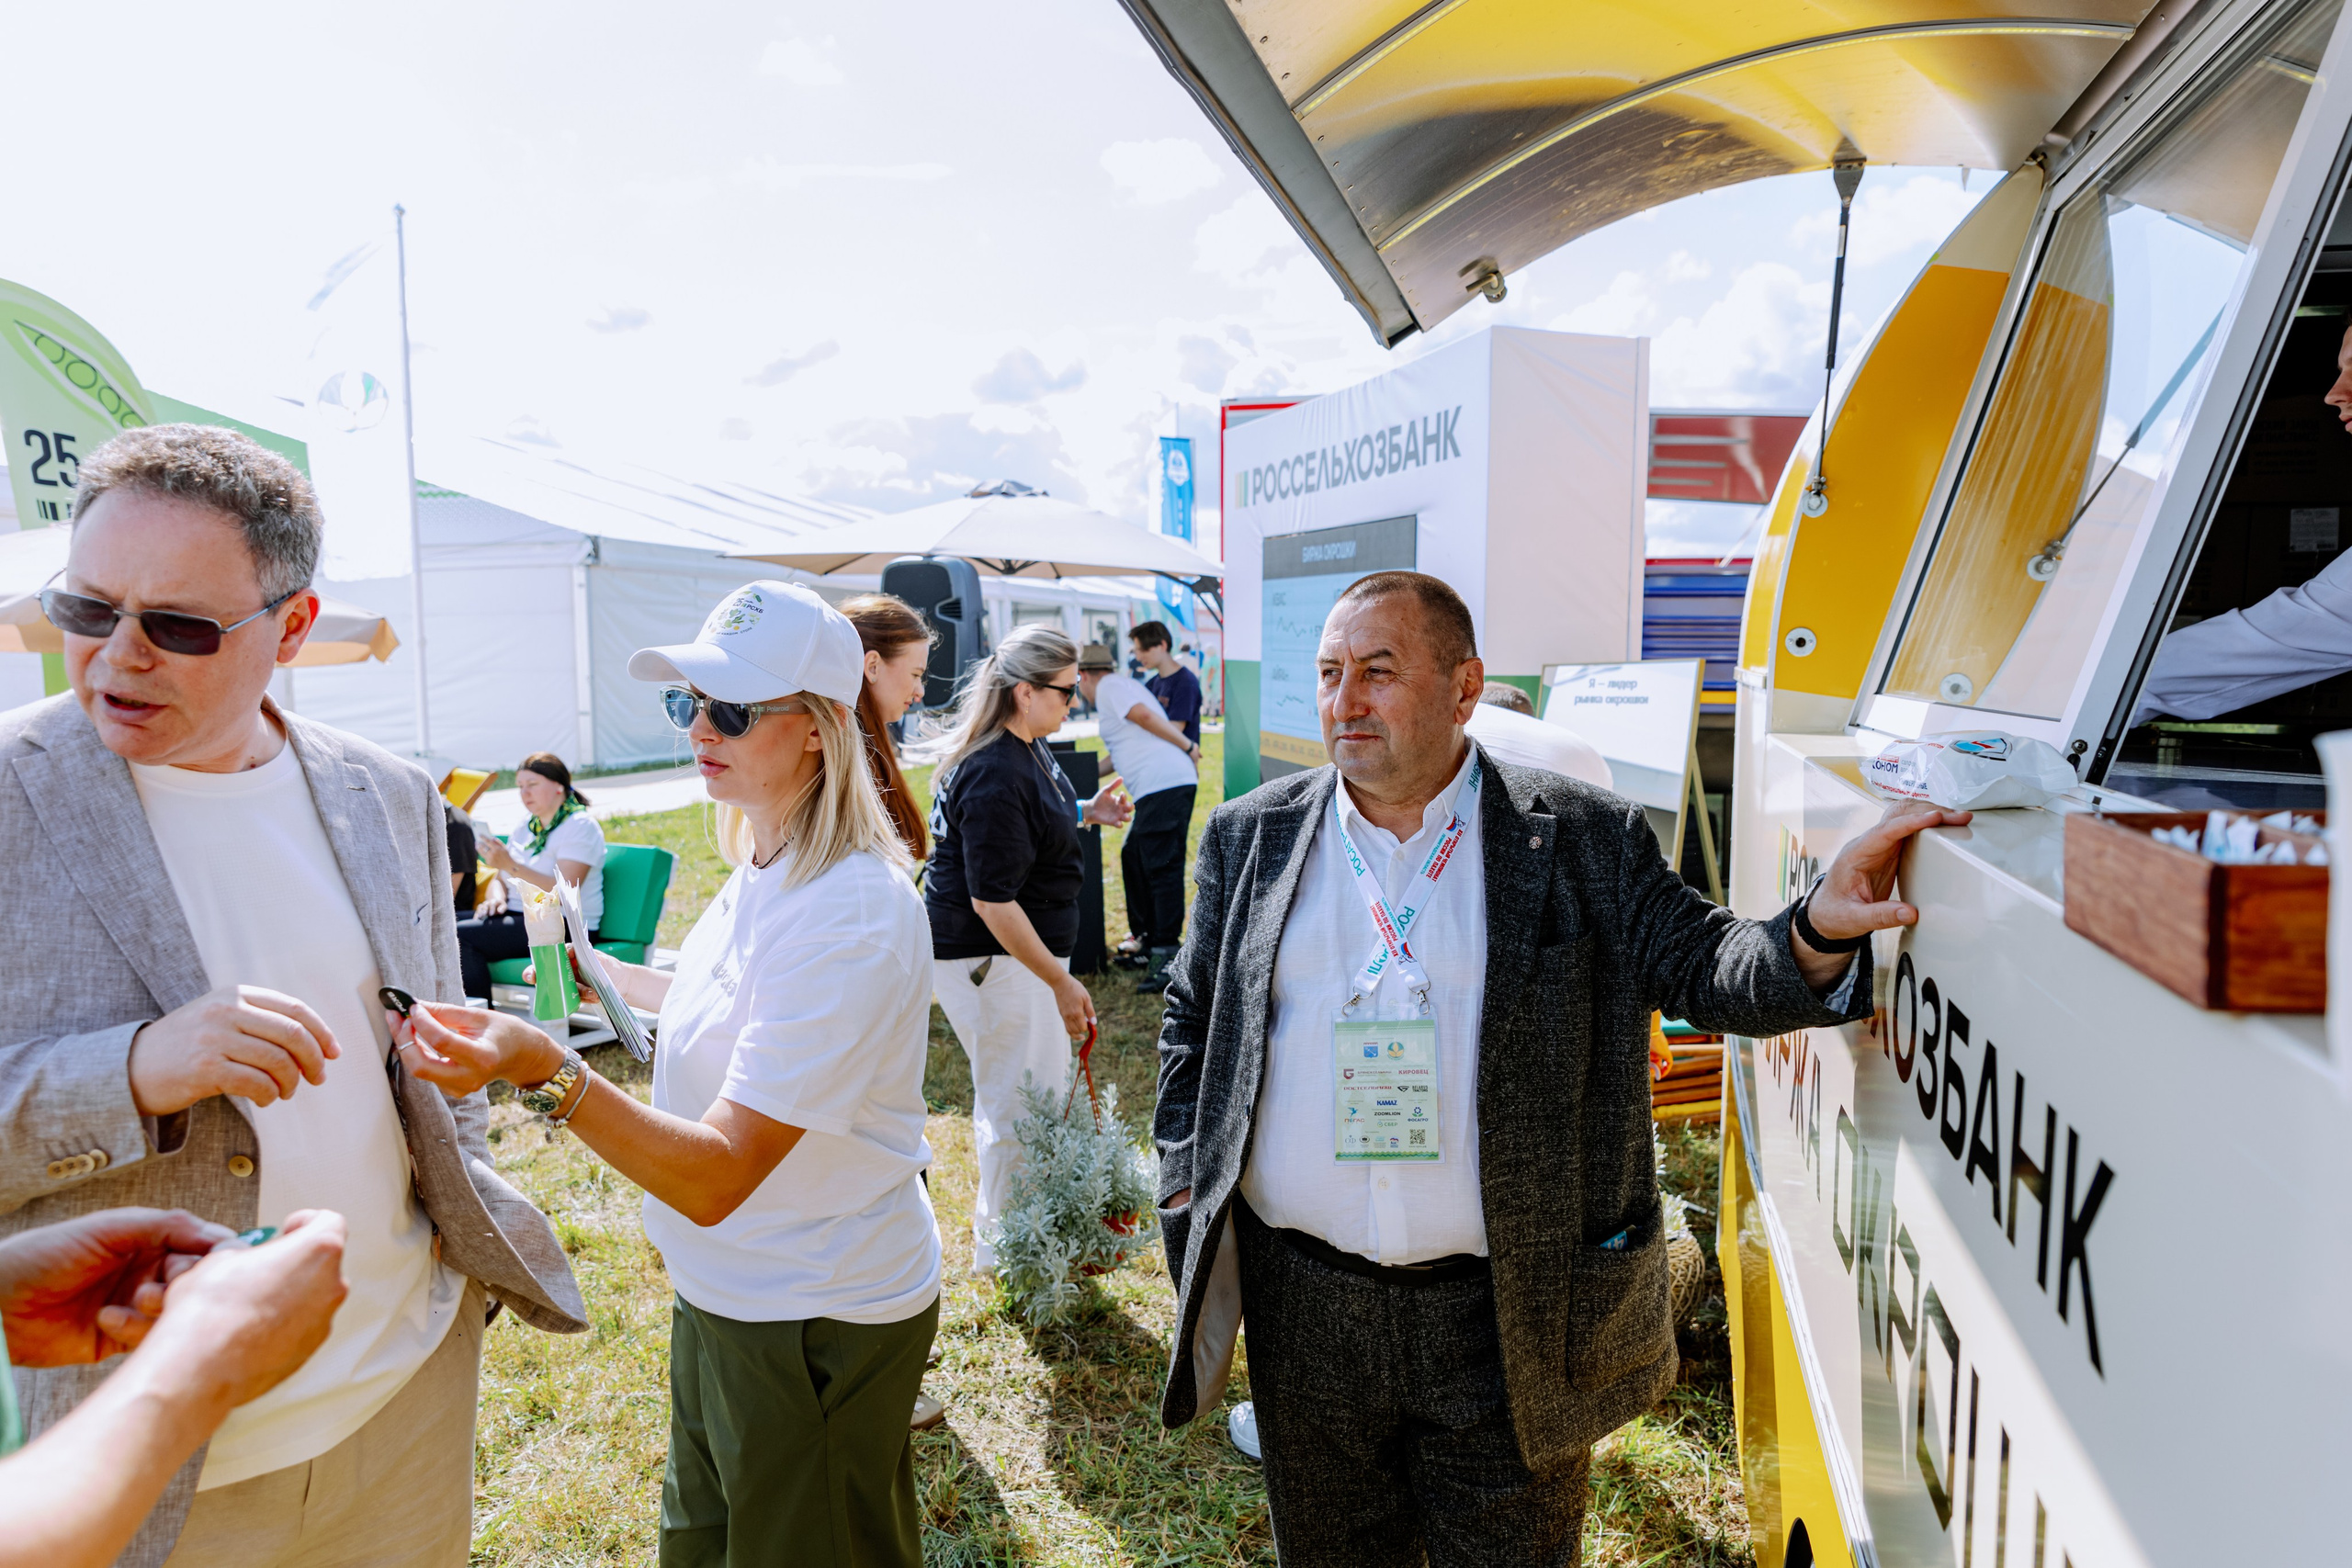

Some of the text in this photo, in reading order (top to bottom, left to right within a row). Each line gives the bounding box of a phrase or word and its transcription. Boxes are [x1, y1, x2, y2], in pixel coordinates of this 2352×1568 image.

[24, 429, 80, 489] 25
[1252, 405, 1463, 506] РОССЕЛЬХОЗБАНК
[746, 604, 764, 614] РСХБ
[1589, 678, 1596, 688] Я
[1608, 679, 1638, 691] лидер
[1574, 695, 1649, 706] рынка окрошки
[1439, 837, 1452, 854] РОССИИ
[1425, 861, 1438, 878] ПАХОТЕ
